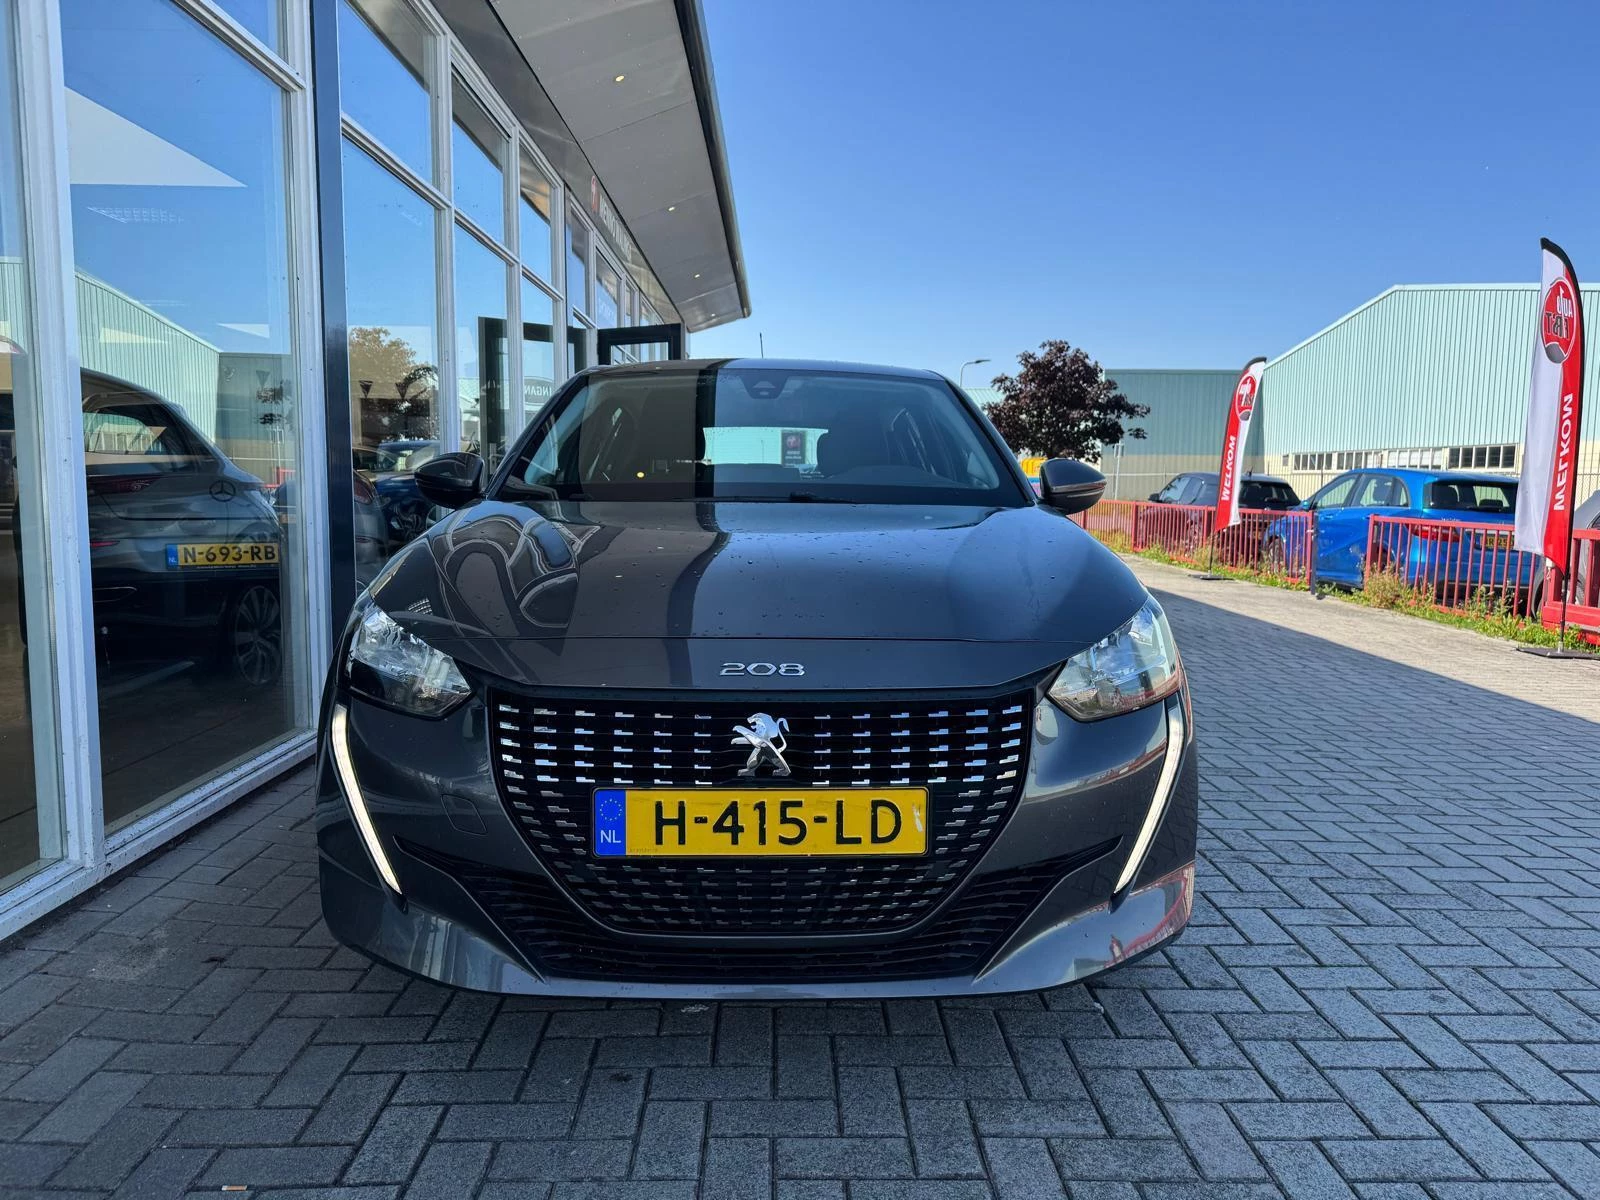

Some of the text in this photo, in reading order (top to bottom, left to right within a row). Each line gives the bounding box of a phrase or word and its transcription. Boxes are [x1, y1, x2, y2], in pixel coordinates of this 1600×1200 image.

[1221, 435, 1236, 501] WELKOM
[183, 545, 276, 563] N-693-RB
[719, 662, 806, 677] 208
[600, 799, 903, 847] NL H-415-LD
